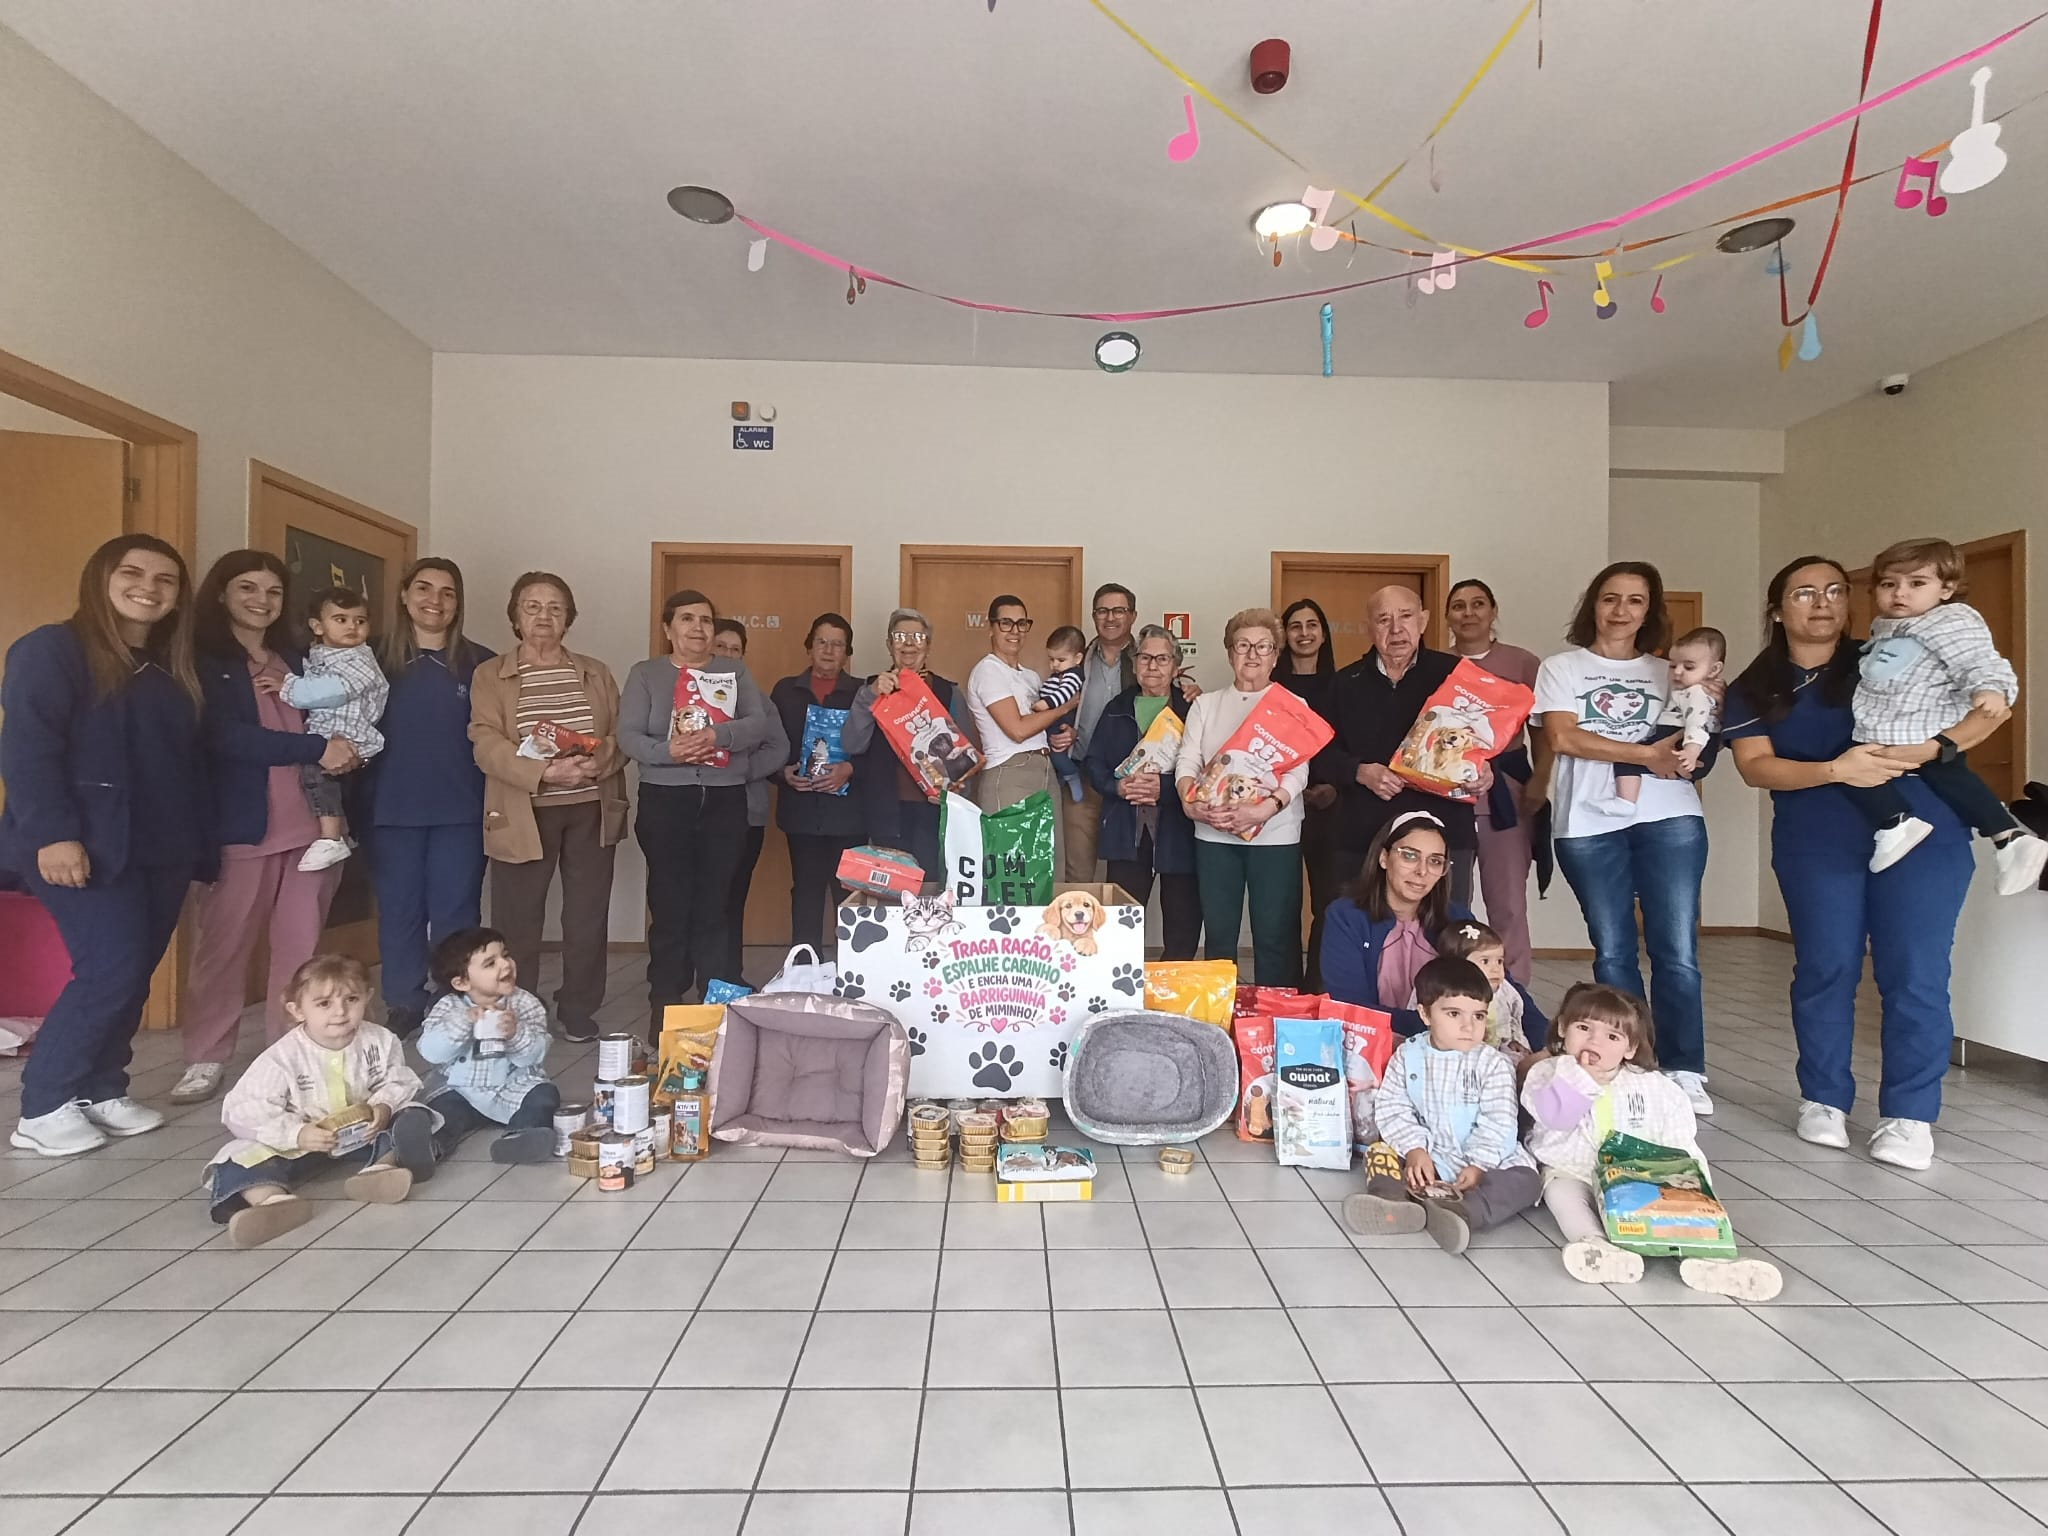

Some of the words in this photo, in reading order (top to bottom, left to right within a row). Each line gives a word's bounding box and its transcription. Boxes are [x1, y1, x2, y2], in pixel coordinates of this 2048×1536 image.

[753, 440, 770, 448] WC
[905, 709, 931, 735] PET
[1248, 737, 1284, 764] PET
[1253, 723, 1299, 760] CONTINENTE
[959, 854, 1026, 879] COM
[957, 881, 1036, 906] PLET
[948, 939, 999, 961] TRAGA
[1001, 935, 1053, 963] RAÇÃO,
[942, 956, 1000, 984] ESPALHE
[1001, 956, 1061, 984] CARINHO
[968, 978, 976, 989] E
[977, 975, 1009, 987] ENCHA
[1011, 975, 1033, 988] UMA
[959, 987, 1046, 1010] BARRIGUINHA
[968, 1006, 983, 1020] DE
[985, 1004, 1038, 1021] MIMINHO!
[1343, 1030, 1368, 1058] ET
[1289, 1072, 1331, 1083] ownat
